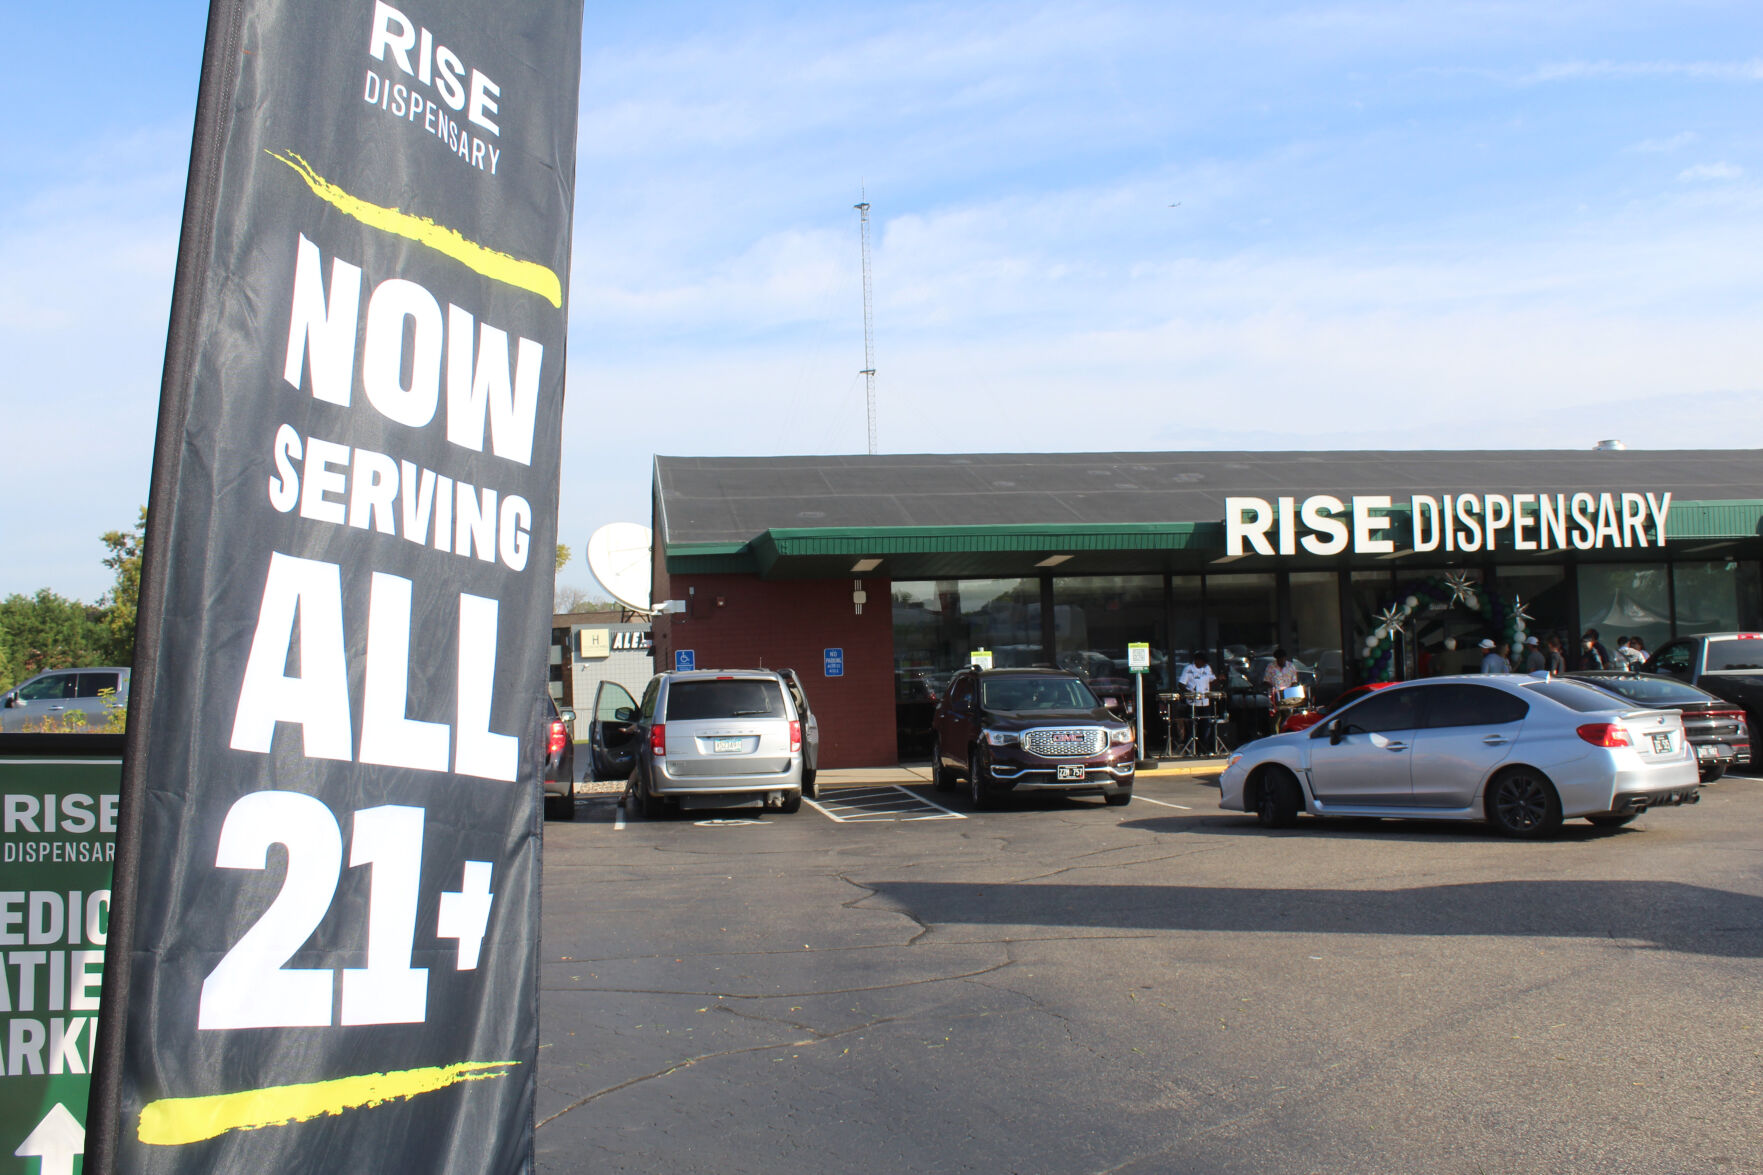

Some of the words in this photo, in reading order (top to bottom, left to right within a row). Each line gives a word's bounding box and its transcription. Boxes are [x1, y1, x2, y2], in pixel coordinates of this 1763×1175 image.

[364, 69, 501, 175] DISPENSARY
[369, 0, 500, 137] RISE
[283, 232, 544, 466] NOW
[268, 423, 532, 572] SERVING
[1224, 494, 1395, 556] RISE
[1410, 491, 1673, 552] DISPENSARY
[229, 550, 519, 783] ALL
[4, 793, 119, 833] RISE
[197, 790, 494, 1030] 21+
